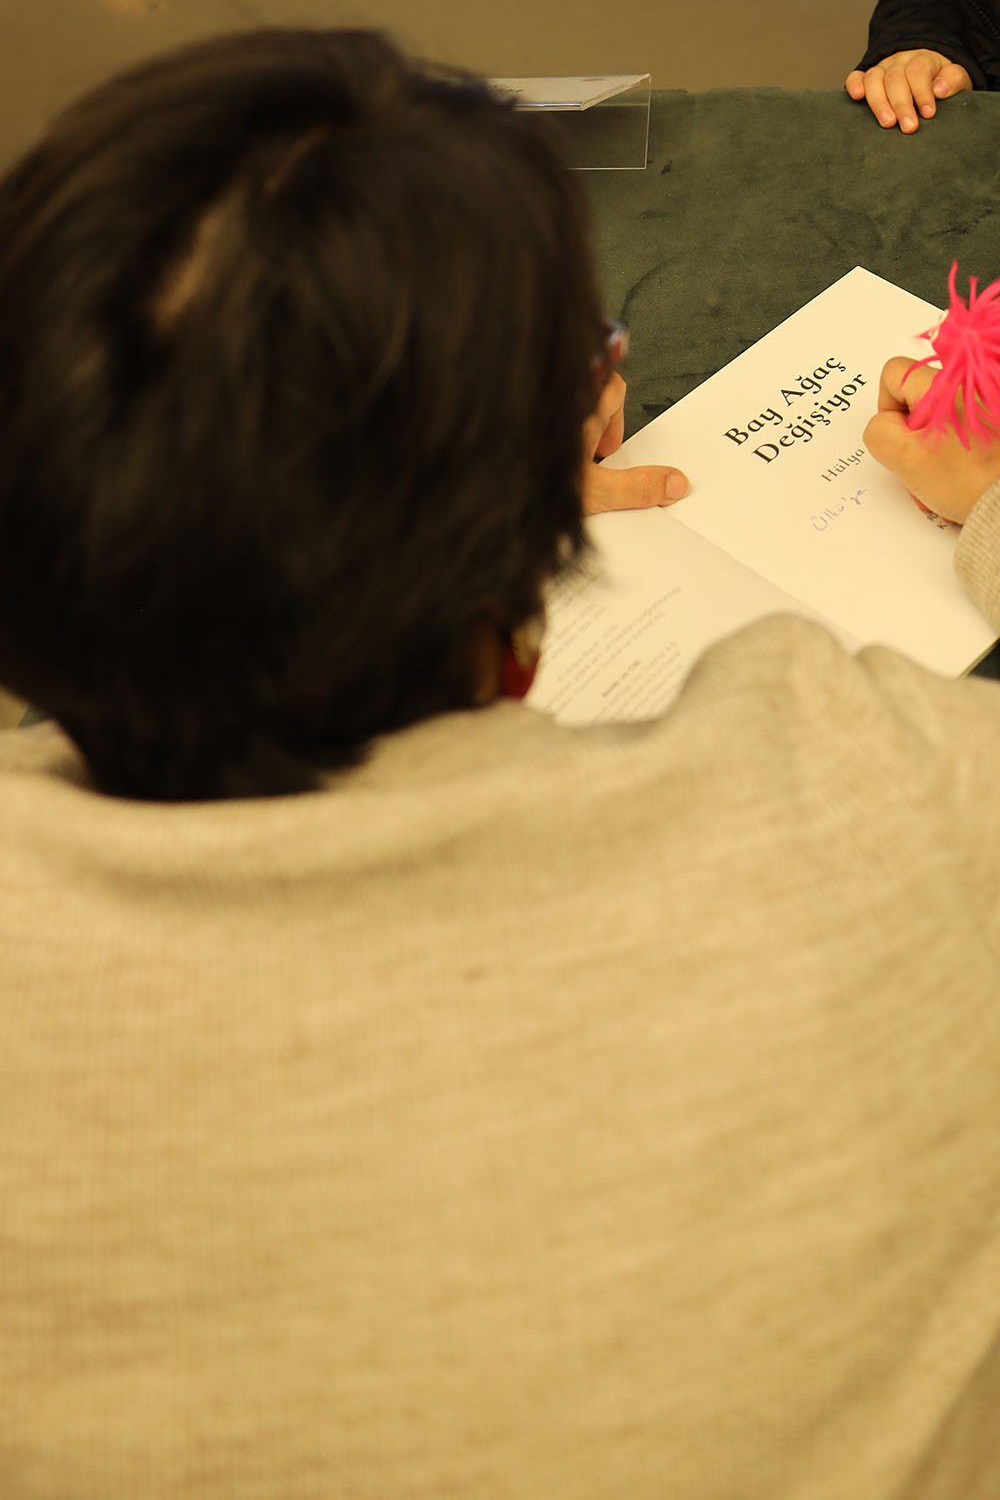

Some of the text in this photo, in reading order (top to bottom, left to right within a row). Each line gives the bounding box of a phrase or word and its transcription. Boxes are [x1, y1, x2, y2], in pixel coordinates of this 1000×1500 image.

[722, 357, 847, 447] Bay Ağaç
[752, 373, 869, 465] Değişiyor
[821, 448, 865, 482] Hülya
